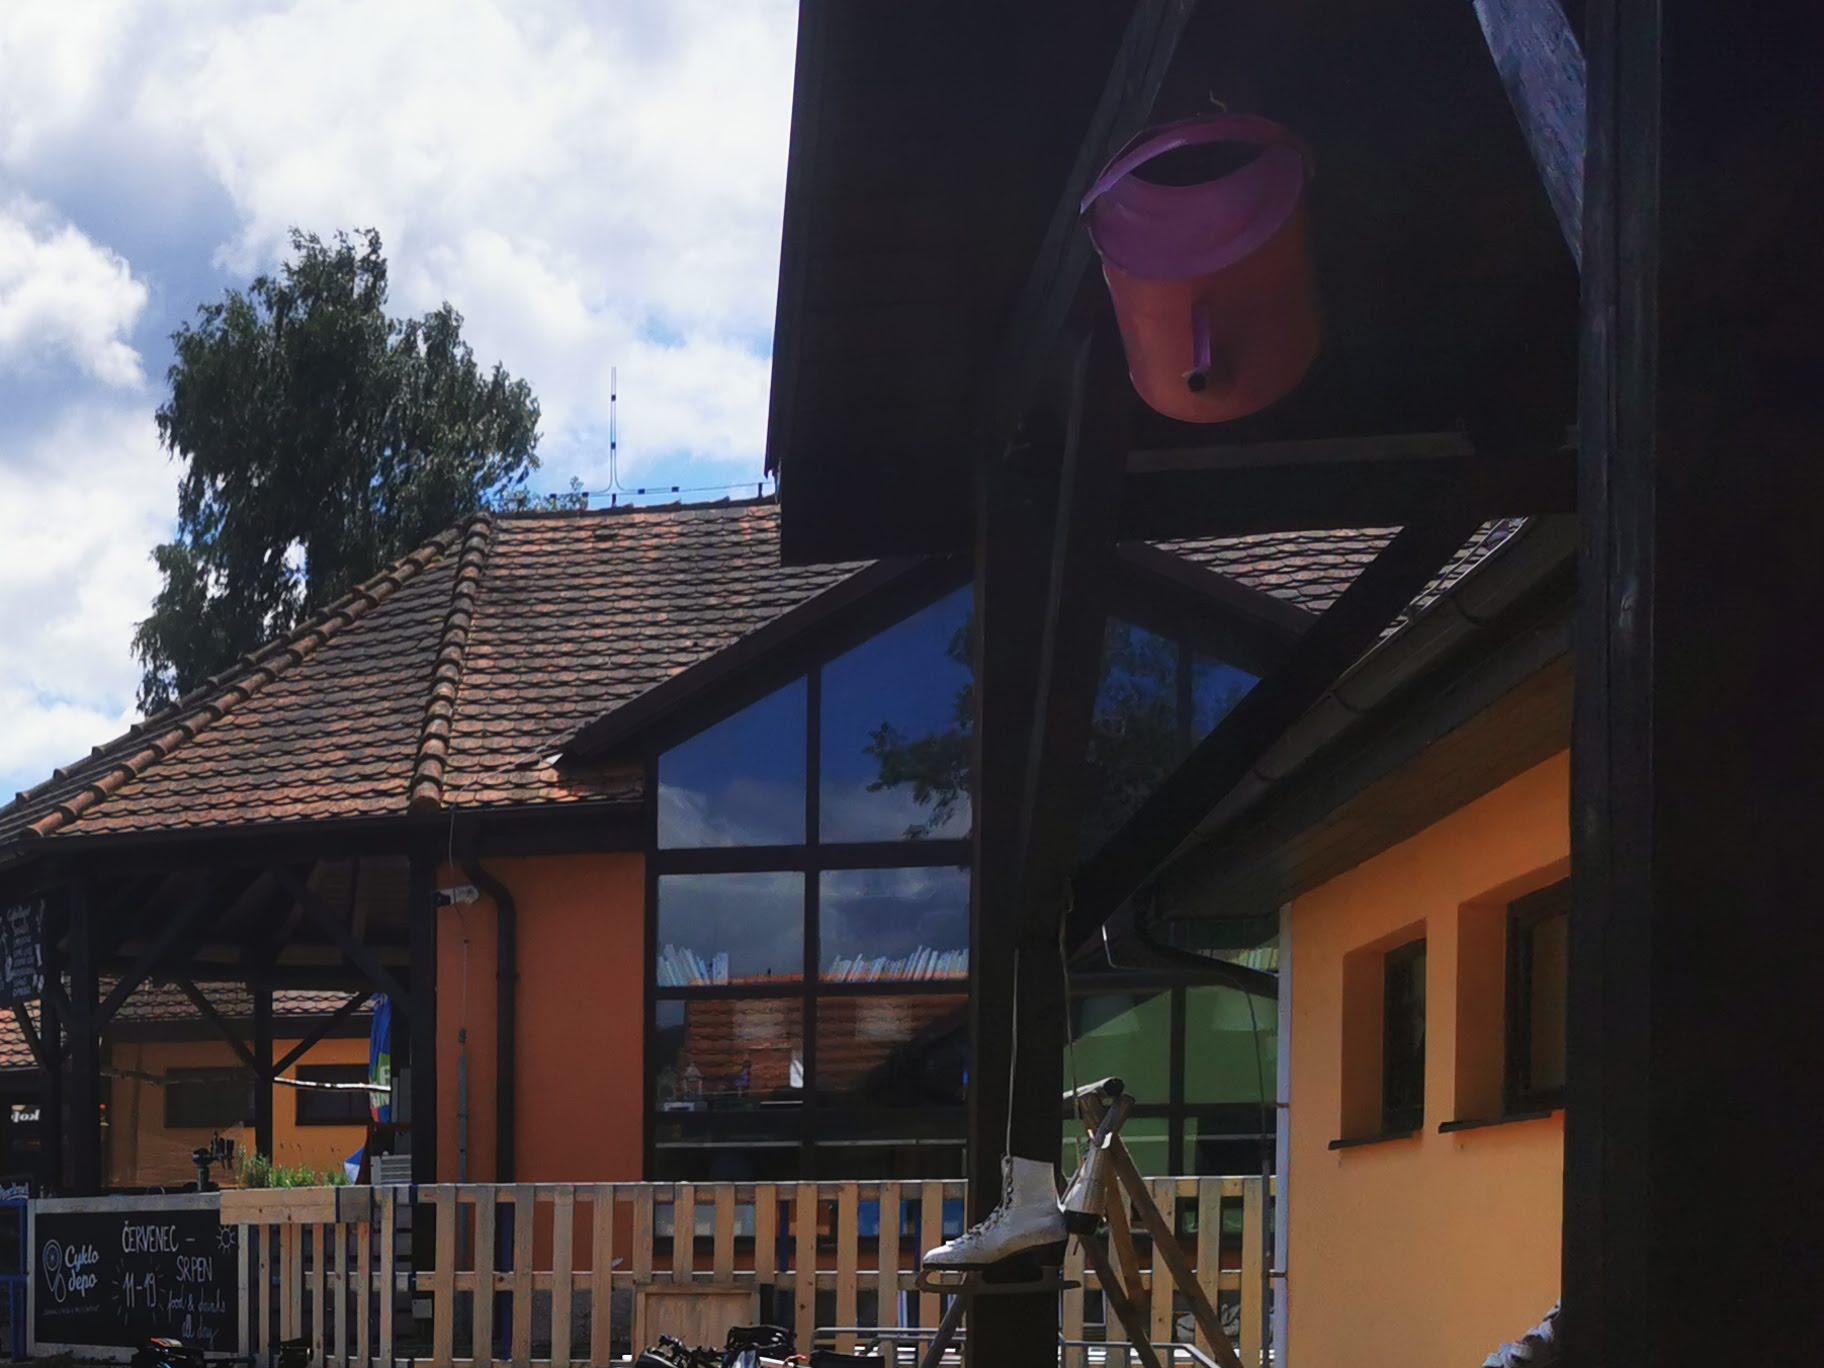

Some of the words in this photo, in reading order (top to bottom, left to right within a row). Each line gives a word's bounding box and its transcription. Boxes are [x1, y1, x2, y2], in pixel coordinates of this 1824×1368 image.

[122, 1220, 179, 1253] ČERVENEC
[65, 1244, 99, 1272] Cyklo
[176, 1255, 213, 1282] SRPEN
[68, 1269, 97, 1297] depo
